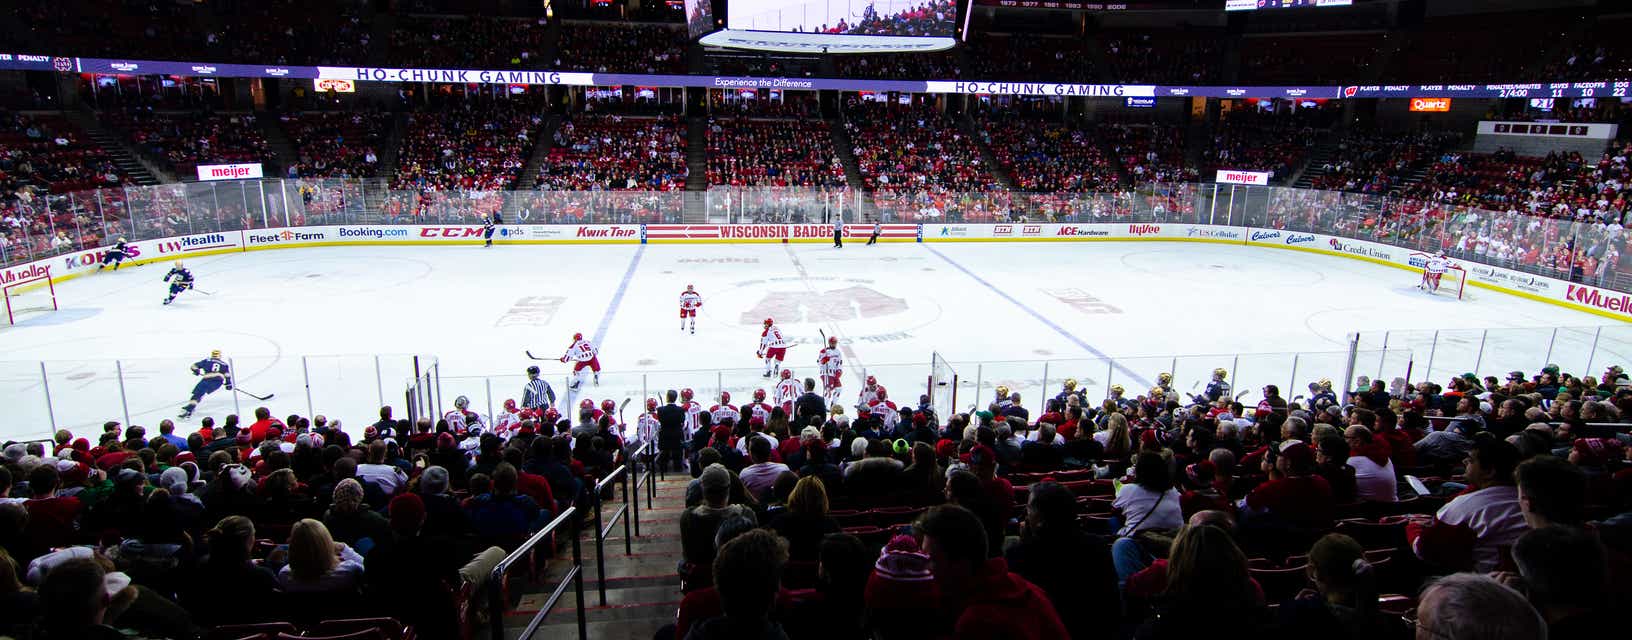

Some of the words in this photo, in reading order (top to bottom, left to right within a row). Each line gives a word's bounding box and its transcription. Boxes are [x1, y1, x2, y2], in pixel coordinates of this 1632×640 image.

[18, 54, 49, 62] PENALTY
[356, 68, 468, 82] HO-CHUNK
[479, 71, 561, 85] GAMING
[714, 77, 757, 88] Experience
[759, 79, 771, 87] the
[773, 79, 812, 88] Difference
[955, 82, 1045, 95] HO-CHUNK
[1054, 84, 1124, 96] GAMING
[1498, 89, 1527, 98] 2/4:00
[1551, 89, 1562, 97] 11
[1581, 88, 1593, 97] 10
[1612, 88, 1625, 97] 22
[1414, 100, 1446, 111] Quartz
[211, 164, 250, 178] meijer
[1226, 171, 1258, 183] meijer
[339, 228, 407, 239] Booking.com
[419, 227, 484, 238] CCM
[719, 225, 788, 239] WISCONSIN
[793, 225, 850, 238] BADGES
[1057, 226, 1079, 236] ACE
[1251, 231, 1280, 241] Culver's
[250, 233, 281, 243] Fleet
[295, 232, 325, 241] Farm
[1286, 234, 1315, 245] Culver's
[1343, 243, 1368, 256] Credit
[1368, 247, 1391, 260] Union
